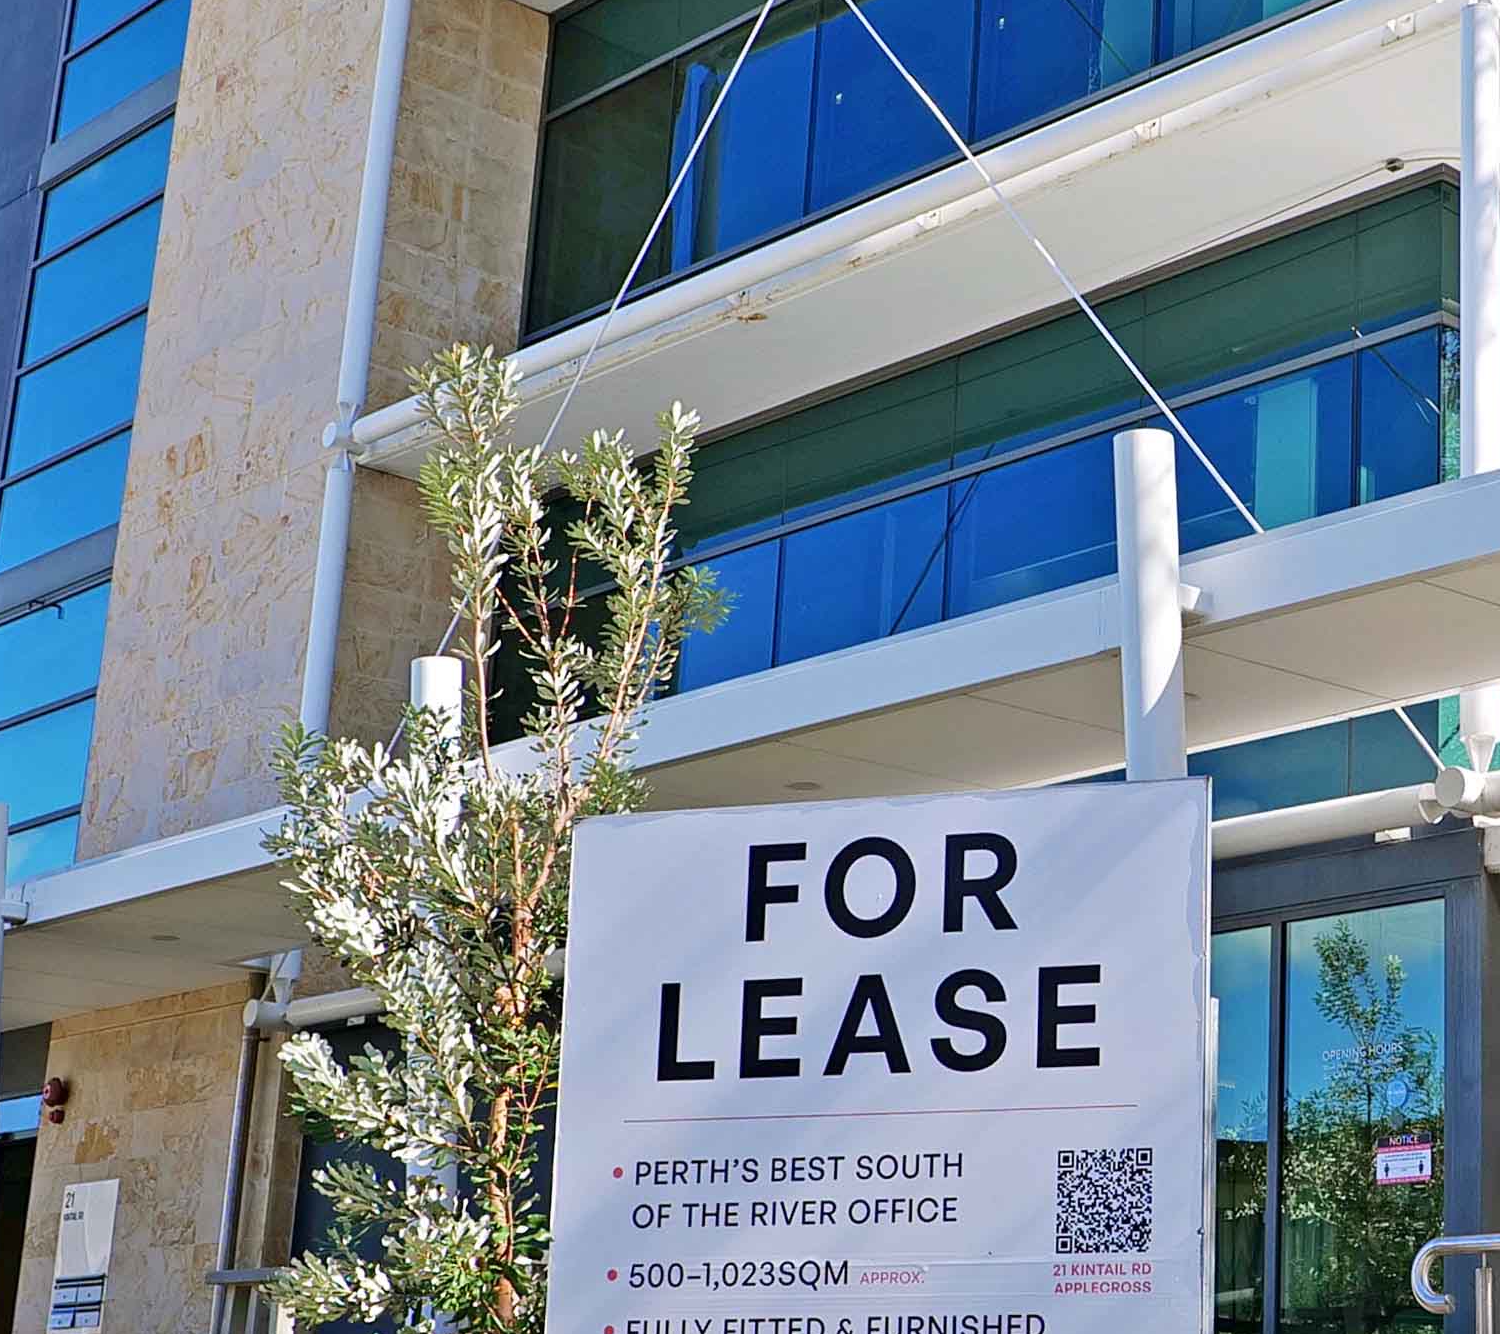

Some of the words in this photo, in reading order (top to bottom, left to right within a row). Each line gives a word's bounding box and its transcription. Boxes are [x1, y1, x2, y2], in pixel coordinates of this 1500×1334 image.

[745, 832, 1019, 943] FOR
[656, 964, 1101, 1082] LEASE
[1322, 1046, 1367, 1061] OPENING
[1368, 1042, 1404, 1058] HOURS
[1388, 1133, 1421, 1146] NOTICE
[635, 1158, 759, 1186] PERTH’S
[770, 1155, 846, 1183] BEST
[855, 1152, 963, 1180] SOUTH
[65, 1192, 76, 1209] 21
[632, 1203, 672, 1229] OF
[681, 1202, 740, 1228] THE
[751, 1200, 837, 1227] RIVER
[848, 1197, 958, 1225] OFFICE
[859, 1269, 926, 1285] APPROX.
[1052, 1263, 1067, 1277] 21
[1071, 1263, 1127, 1276] KINTAIL
[1129, 1262, 1152, 1276] RD
[1053, 1280, 1152, 1294] APPLECROSS
